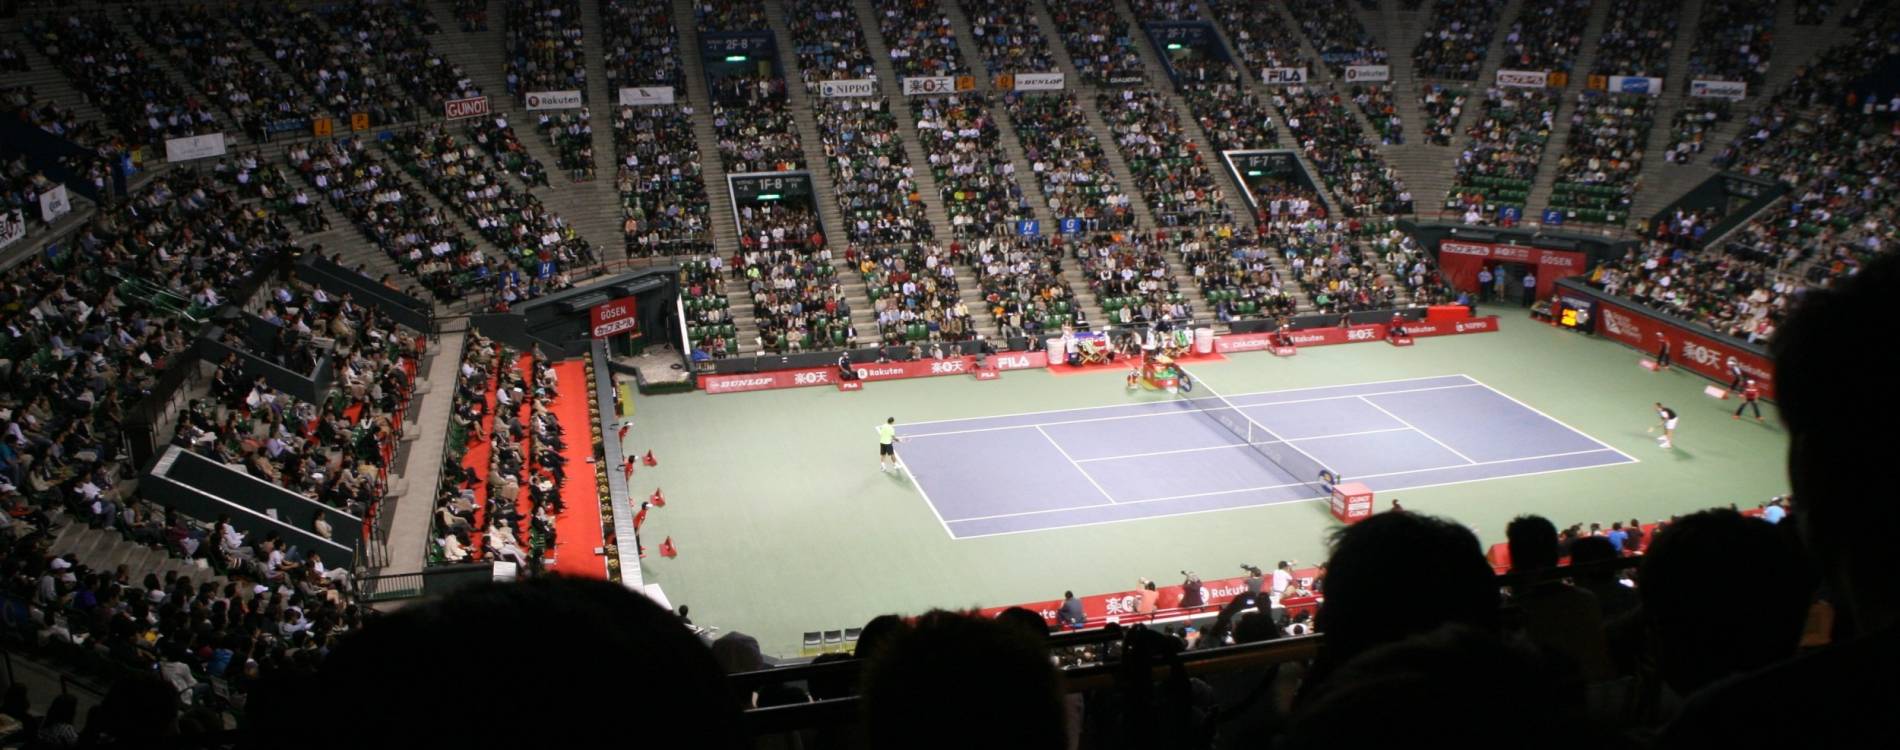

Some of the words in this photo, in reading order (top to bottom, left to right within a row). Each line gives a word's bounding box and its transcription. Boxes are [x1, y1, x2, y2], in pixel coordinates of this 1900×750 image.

[1269, 70, 1301, 82] FILA
[836, 84, 870, 95] NIPPO
[542, 96, 579, 106] Rakuten
[449, 101, 487, 117] GUINOT
[759, 178, 783, 190] 1F-8
[1023, 221, 1033, 231] H
[1066, 219, 1076, 228] G
[1540, 256, 1573, 266] GOSEN
[600, 306, 627, 320] GOSEN
[998, 357, 1030, 368] FILA
[869, 367, 904, 377] Rakuten
[720, 377, 773, 388] DUNLOP
